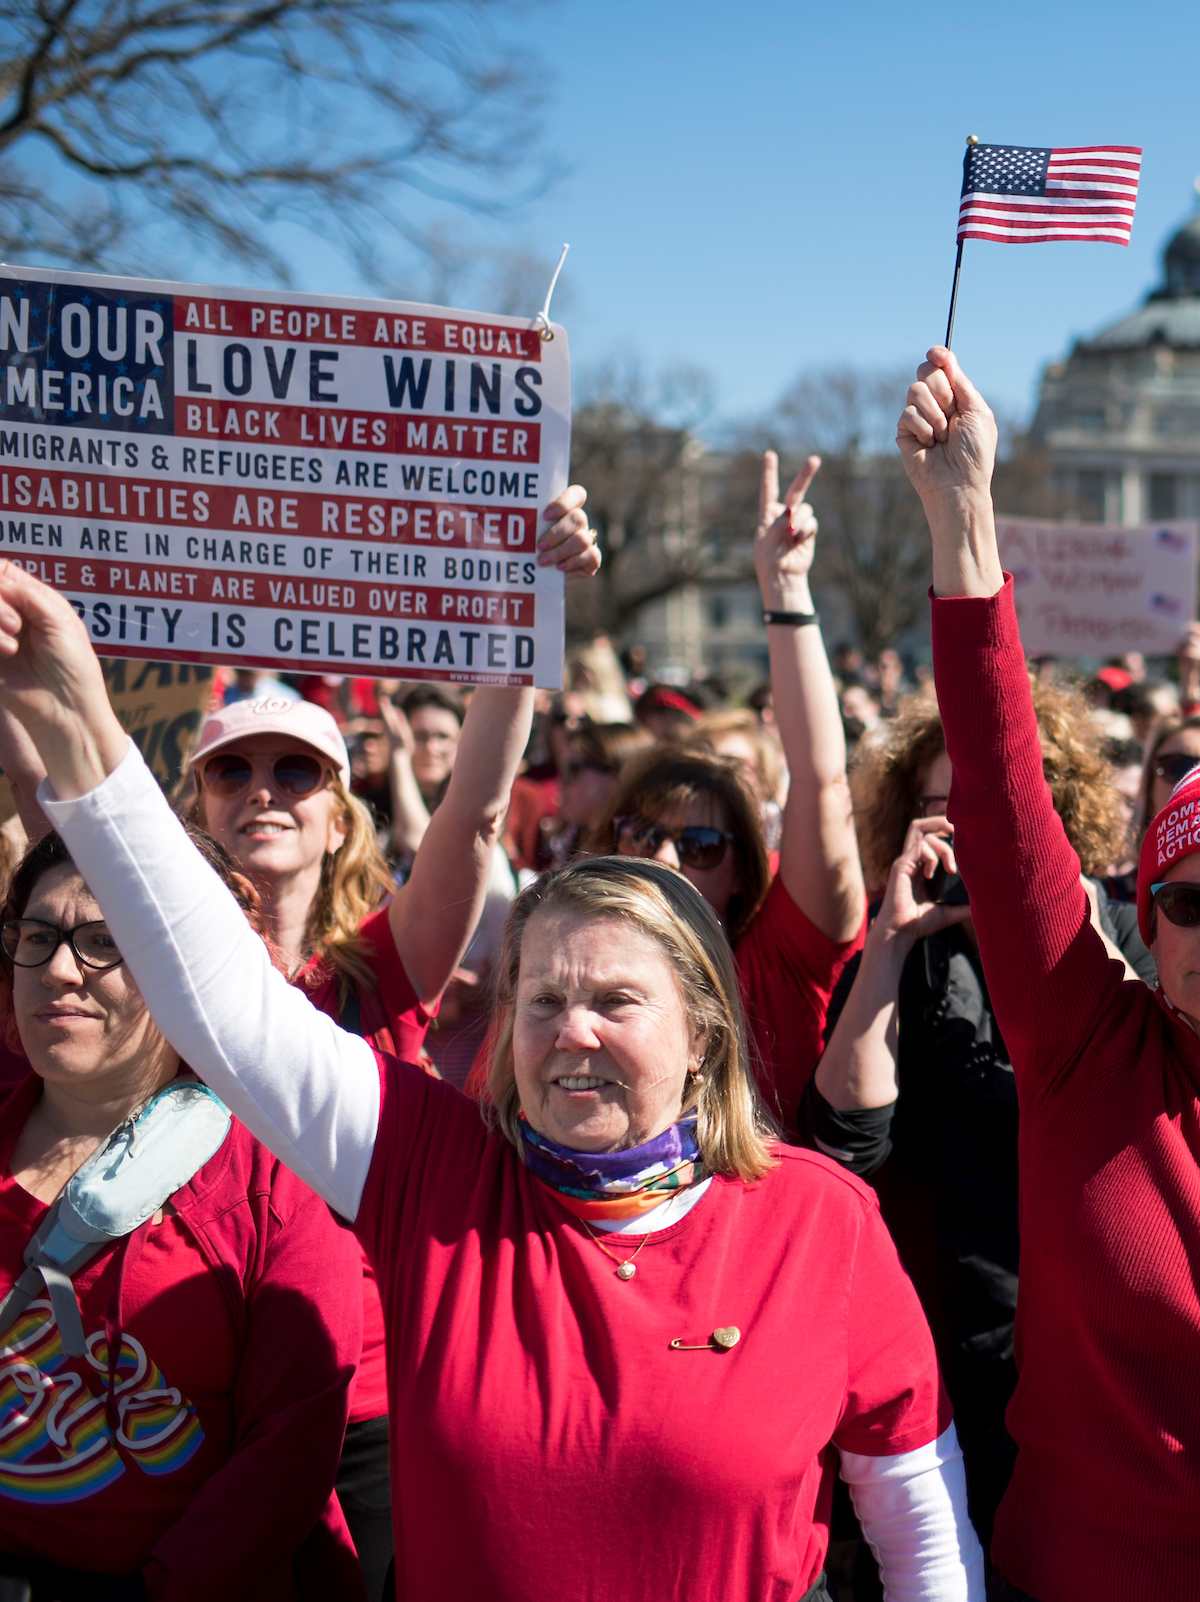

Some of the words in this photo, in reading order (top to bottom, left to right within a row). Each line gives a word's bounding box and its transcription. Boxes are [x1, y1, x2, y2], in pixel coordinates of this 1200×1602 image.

[61, 302, 165, 366] OUR
[185, 302, 234, 331] ALL
[251, 308, 357, 342] PEOPLE
[373, 317, 427, 347] ARE
[444, 325, 530, 357] EQUAL
[0, 365, 165, 419] MERICA
[186, 338, 341, 403] LOVE
[383, 355, 544, 417] WINS
[186, 404, 282, 438] BLACK
[300, 415, 387, 447] LIVES
[406, 420, 530, 457] MATTER
[151, 444, 170, 471] &
[183, 447, 323, 483] REFUGEES
[335, 459, 389, 489] ARE
[402, 464, 539, 498] WELCOME
[233, 493, 299, 530] ARE
[321, 500, 526, 546] RESPECTED
[80, 527, 128, 554] ARE
[145, 533, 170, 557] IN
[186, 536, 288, 567] CHARGE
[303, 546, 334, 570] OF
[350, 549, 427, 578] THEIR
[444, 557, 536, 585] BODIES
[80, 565, 96, 588] &
[109, 567, 198, 595] PLANET
[211, 576, 256, 601] ARE
[268, 580, 356, 609] VALUED
[369, 588, 428, 615] OVER
[441, 594, 524, 621] PROFIT
[211, 611, 246, 649] IS
[274, 616, 535, 670] CELEBRATED
